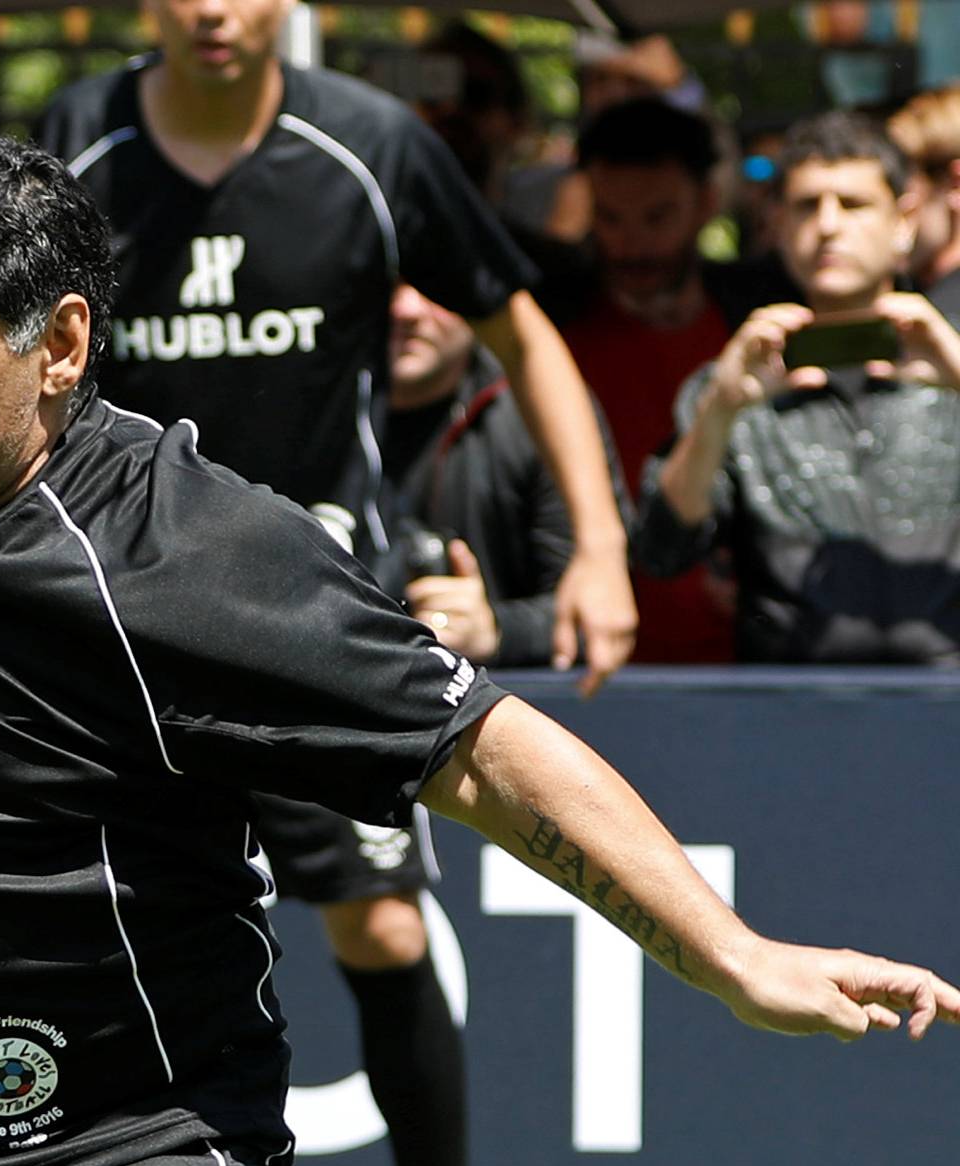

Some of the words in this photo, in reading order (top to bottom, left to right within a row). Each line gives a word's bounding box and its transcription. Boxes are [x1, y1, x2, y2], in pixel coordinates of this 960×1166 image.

[112, 306, 324, 361] HUBLOT
[9, 1120, 32, 1136] 9th
[32, 1106, 64, 1129] 2016
